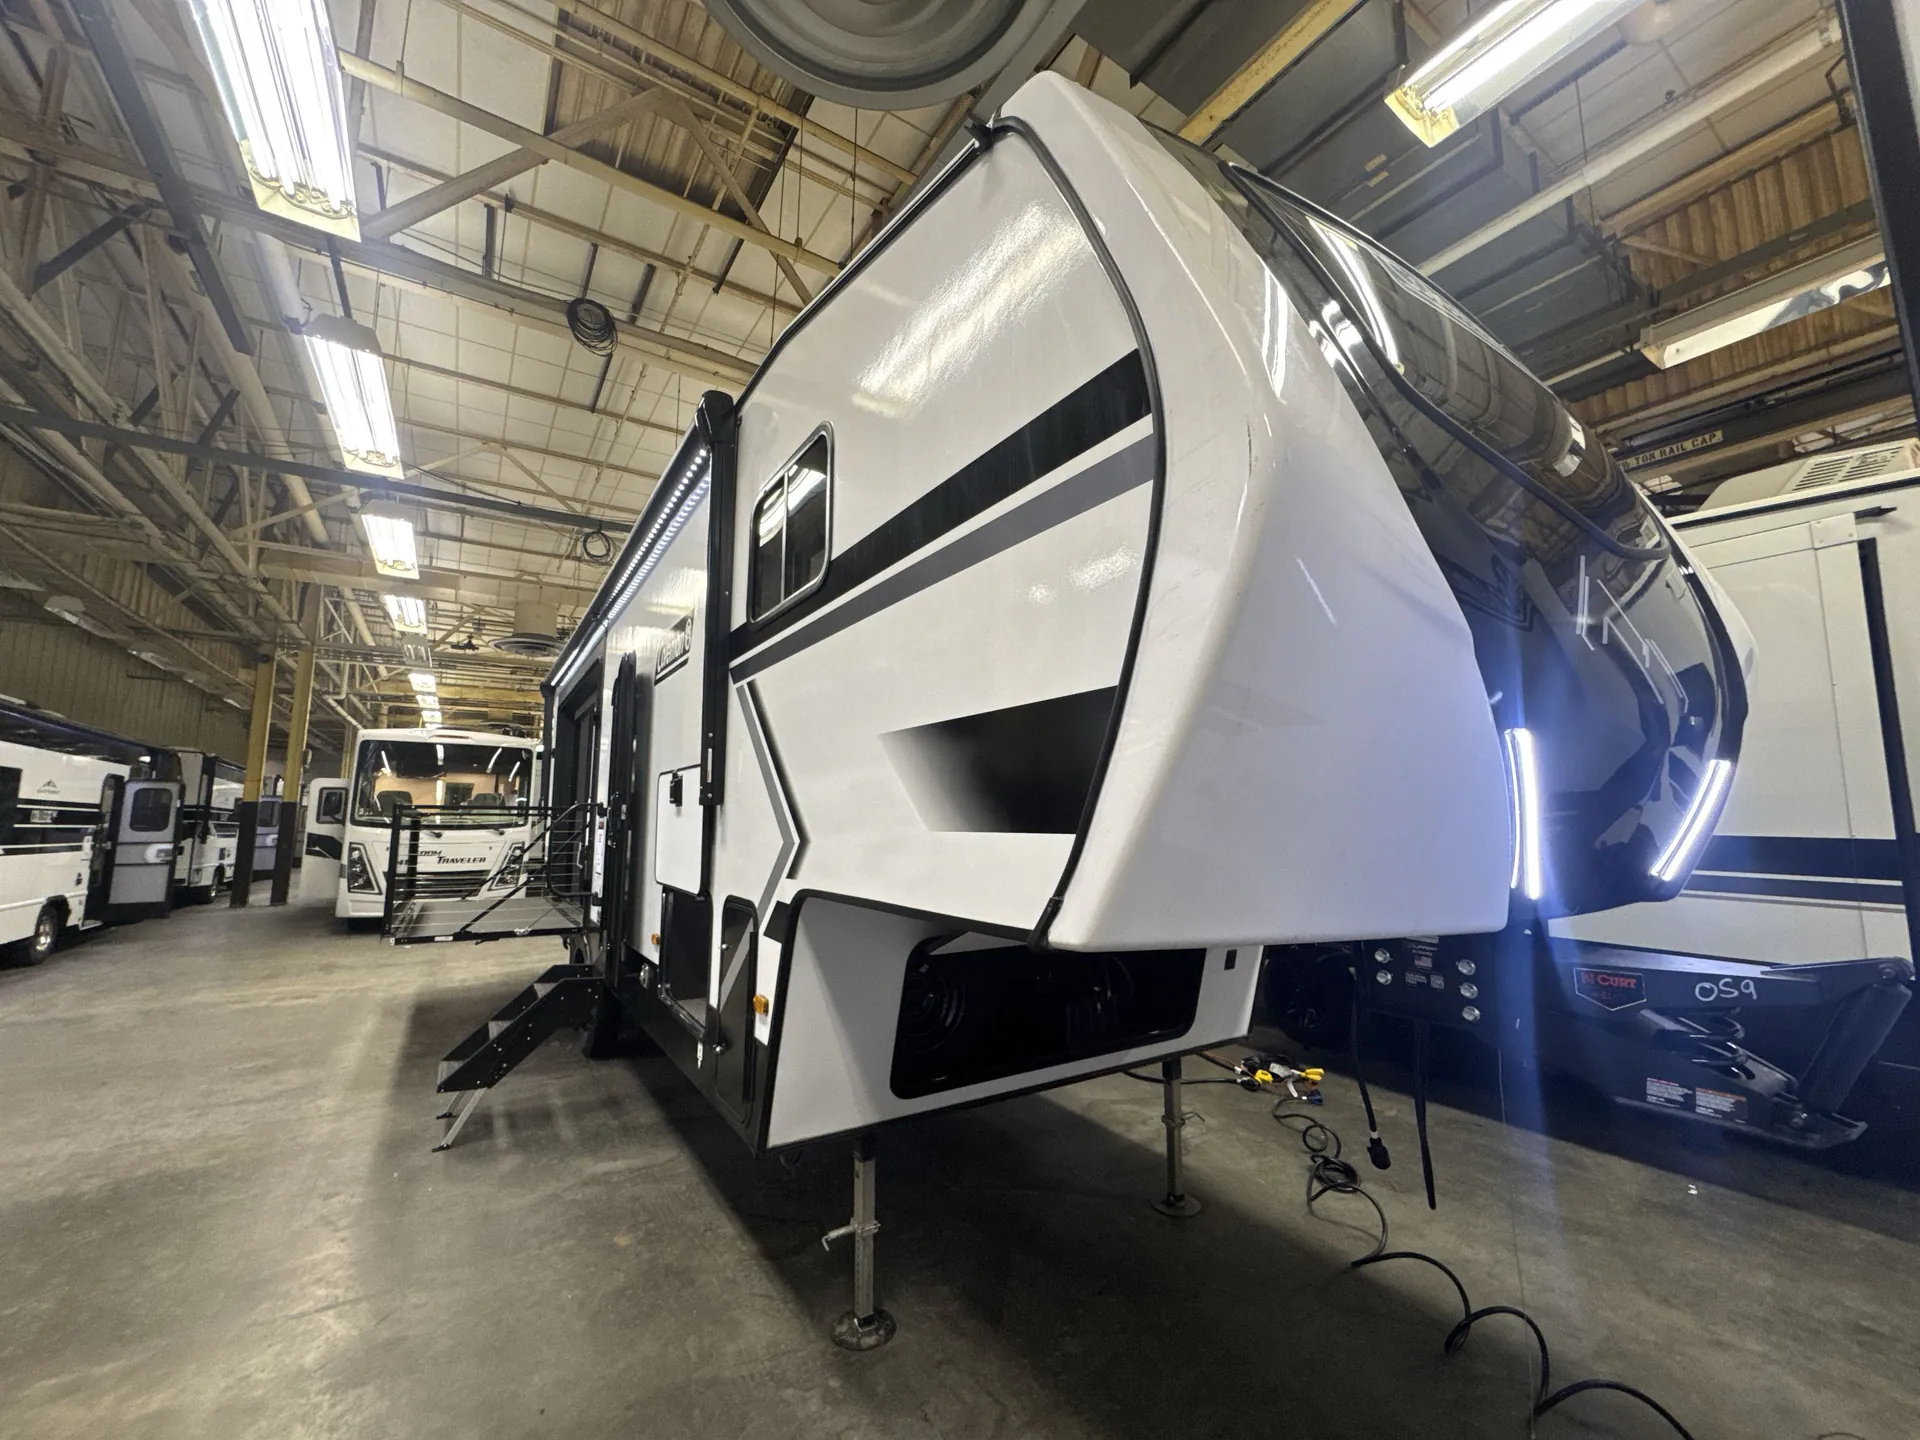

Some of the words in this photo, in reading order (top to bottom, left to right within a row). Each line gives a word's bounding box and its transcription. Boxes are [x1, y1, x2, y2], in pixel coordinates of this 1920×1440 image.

[1635, 451, 1657, 465] TON
[1660, 443, 1687, 458] RAIL
[1597, 974, 1637, 989] CURT
